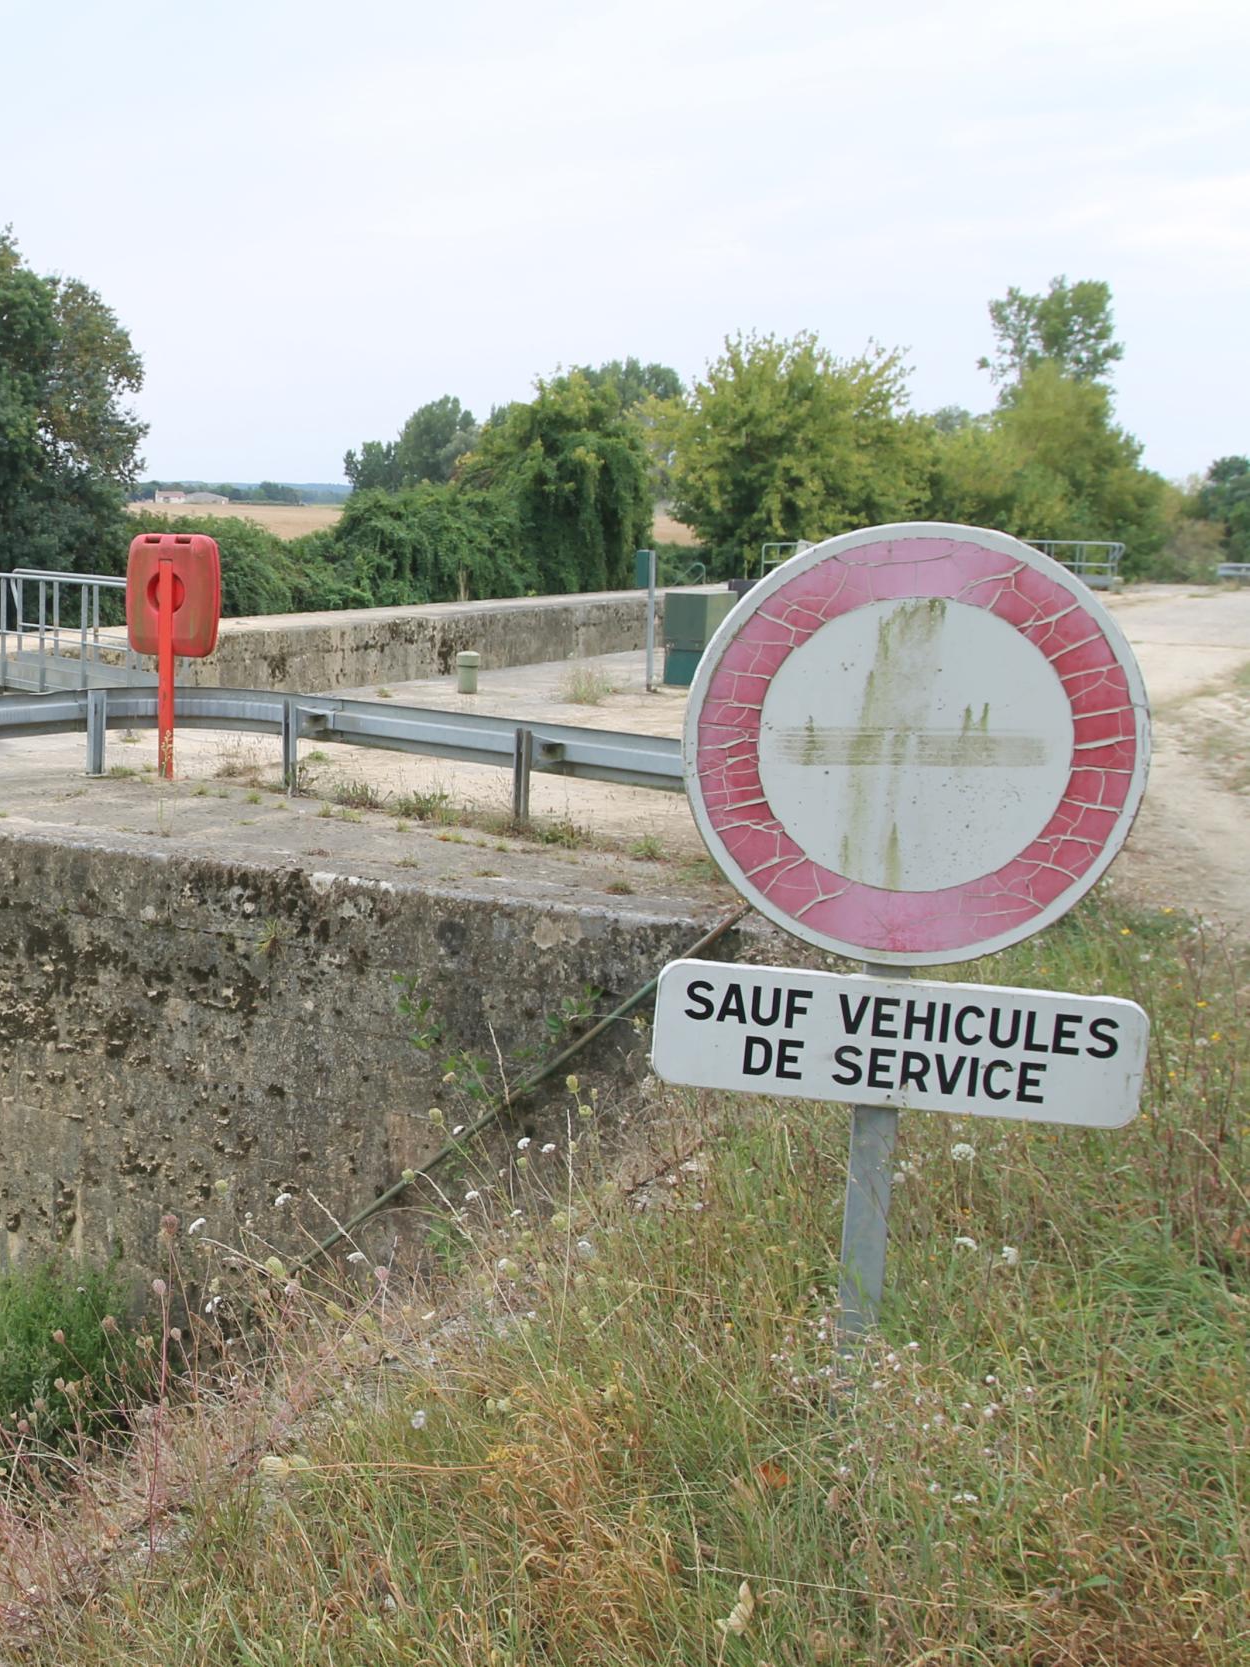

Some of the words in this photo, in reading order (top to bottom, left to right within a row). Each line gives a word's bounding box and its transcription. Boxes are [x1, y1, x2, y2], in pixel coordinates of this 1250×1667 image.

[684, 980, 813, 1029] SAUF
[839, 993, 1120, 1059] VEHICULES
[742, 1035, 805, 1081] DE
[832, 1045, 1047, 1104] SERVICE
